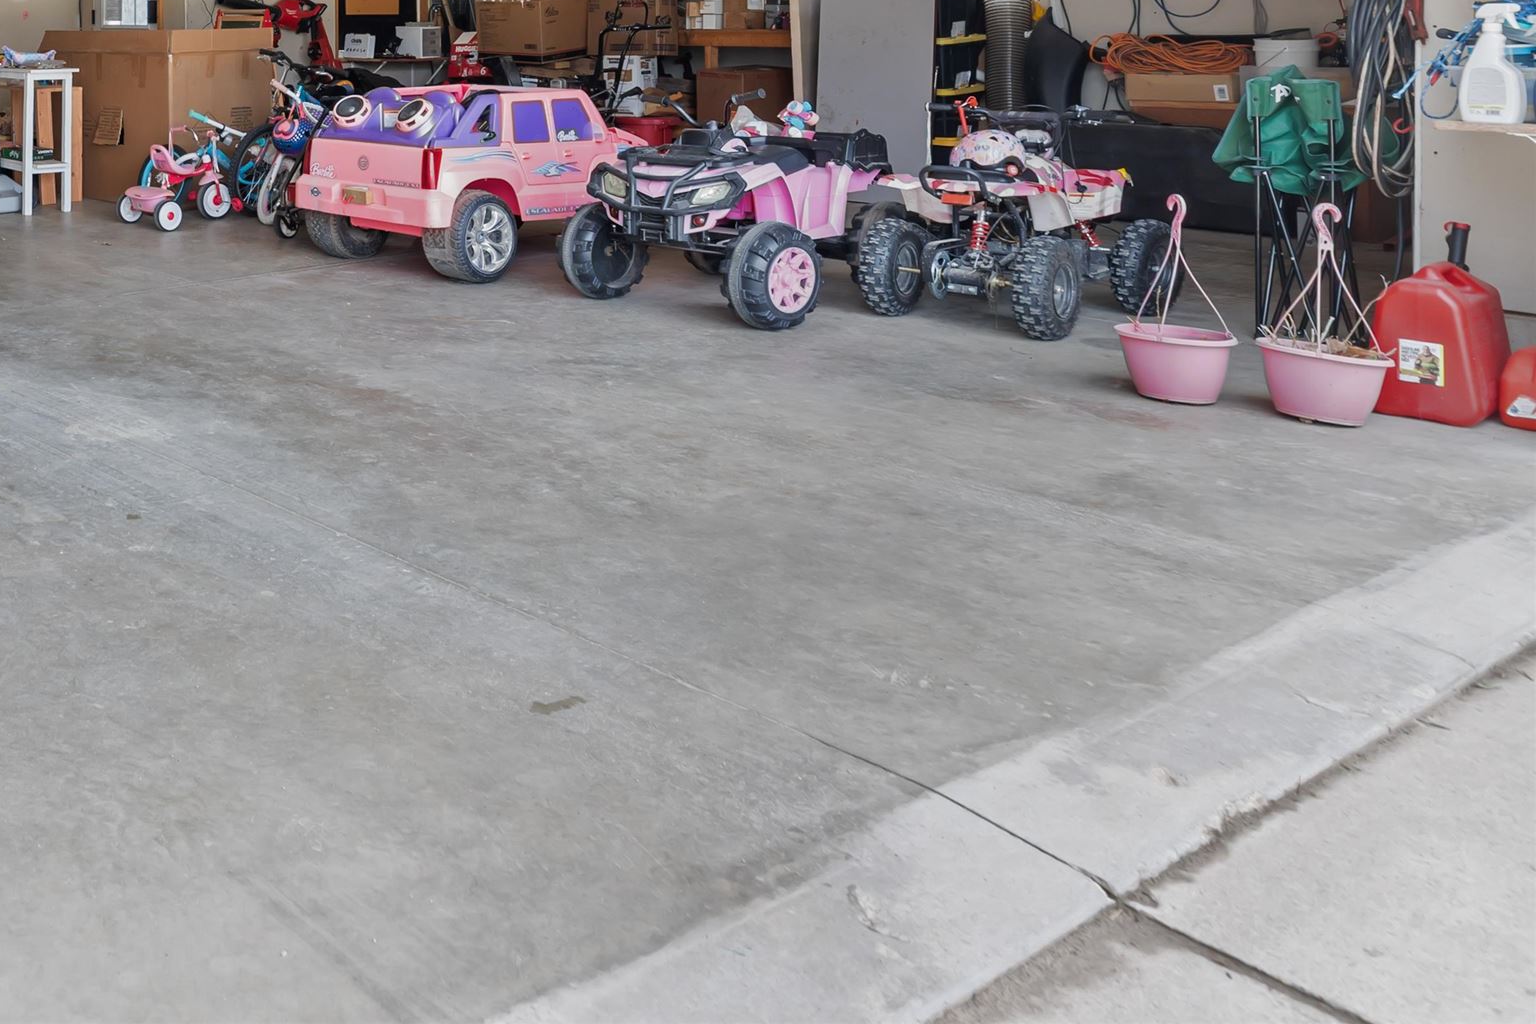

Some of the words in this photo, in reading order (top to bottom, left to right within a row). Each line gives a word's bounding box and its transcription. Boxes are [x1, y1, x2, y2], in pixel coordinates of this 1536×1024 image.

[480, 67, 487, 75] 6
[311, 162, 336, 179] Barbie
[526, 206, 566, 216] ESCALADE
